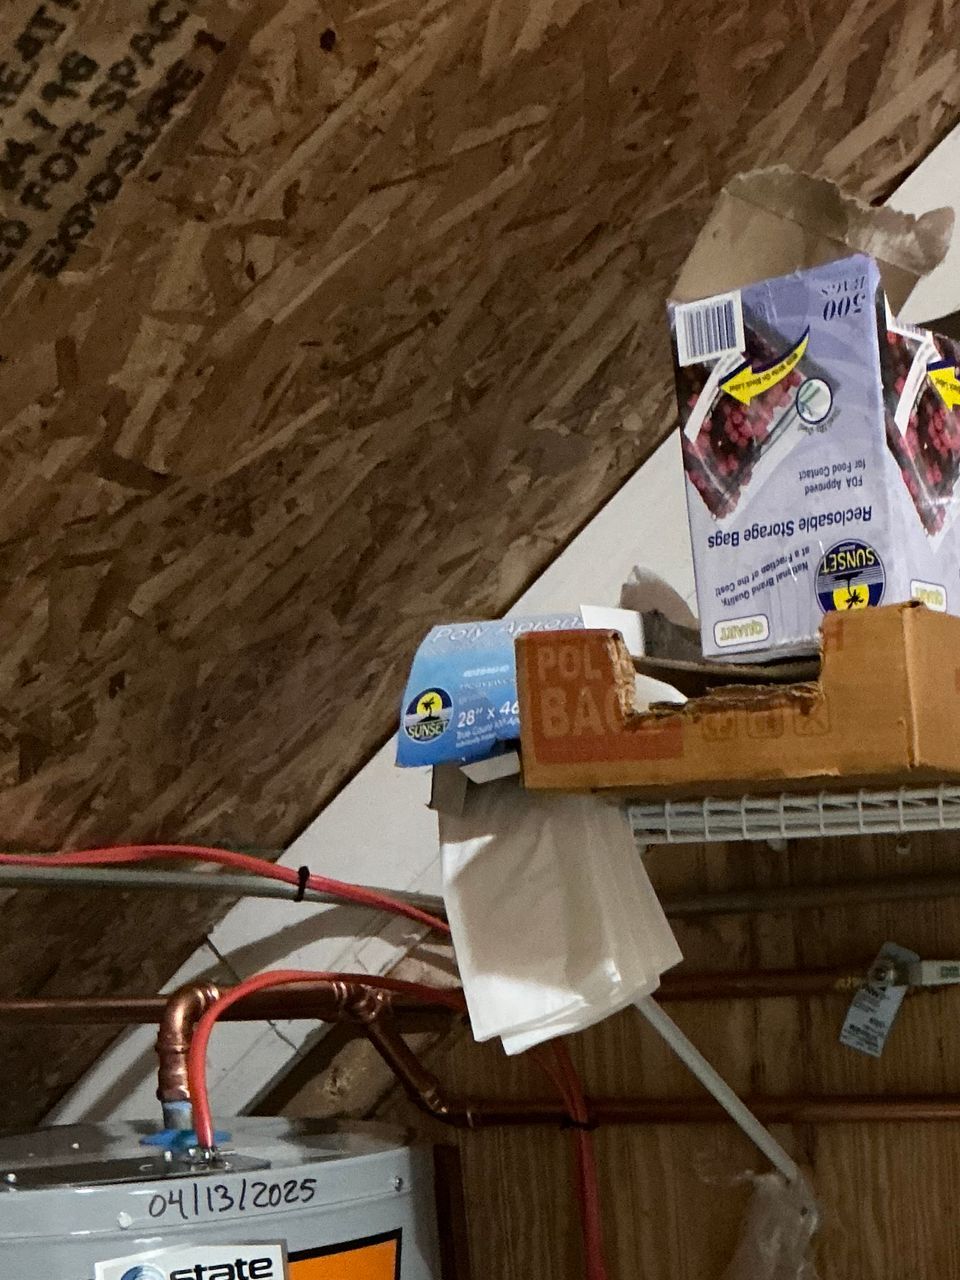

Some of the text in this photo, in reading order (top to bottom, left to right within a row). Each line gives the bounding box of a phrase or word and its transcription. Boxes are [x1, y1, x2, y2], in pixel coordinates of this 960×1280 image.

[20, 121, 106, 211] FOR
[823, 293, 866, 322] 500
[799, 458, 866, 480] for Food Contact
[804, 476, 863, 496] FDA Approved
[707, 505, 873, 549] Reclosable Storage Bags
[800, 546, 810, 555] at
[822, 547, 876, 574] SUNSET
[761, 554, 793, 570] Fraction
[720, 561, 809, 607] National Brand Quality,
[737, 576, 750, 587] the
[752, 571, 760, 581] of
[715, 582, 736, 597] Cost!
[719, 620, 765, 641] QUART
[487, 709, 495, 719] x
[408, 718, 450, 738] SUNSET
[149, 1178, 318, 1220] 04/13/2025
